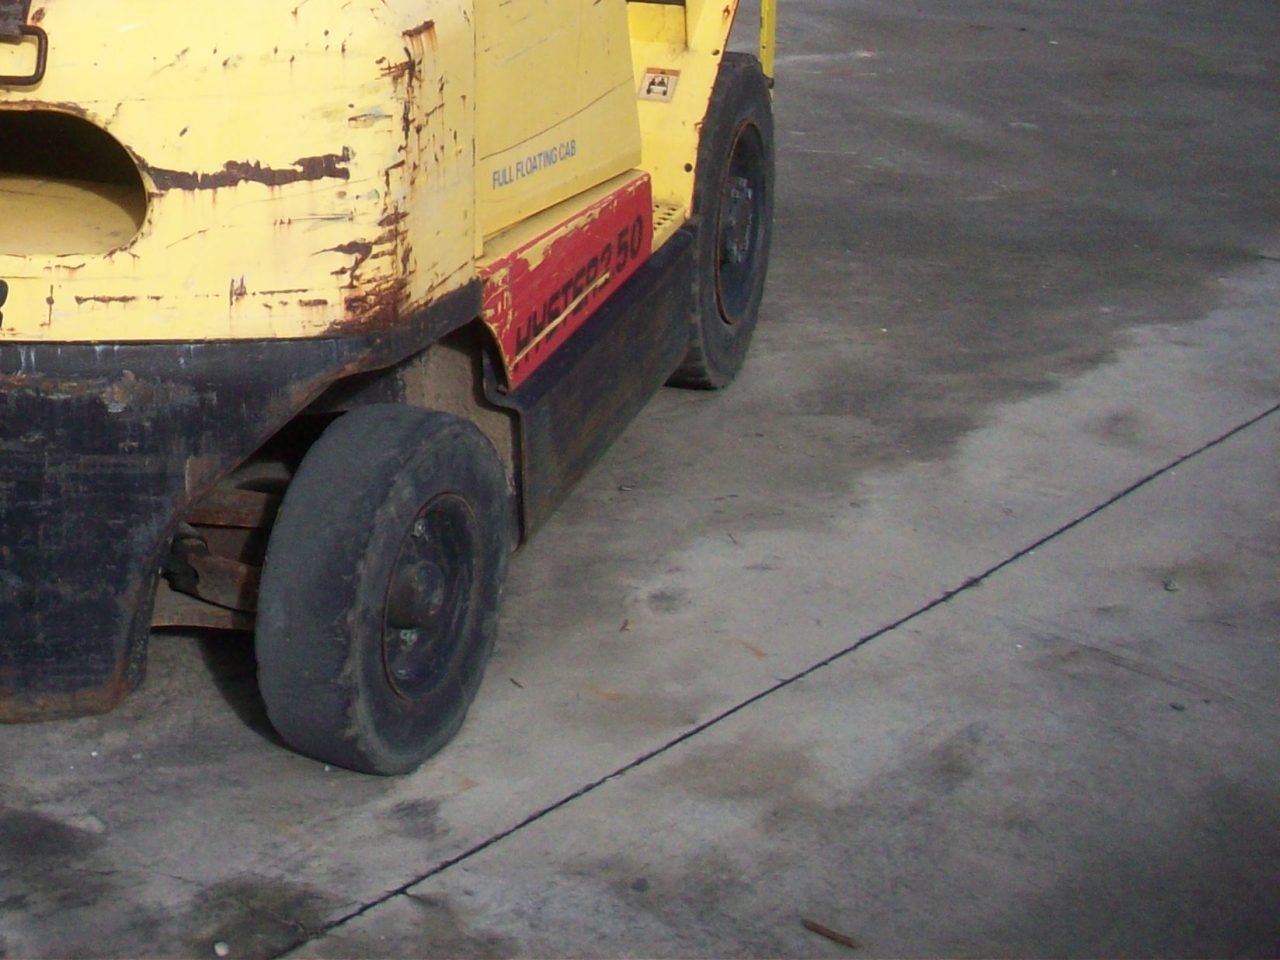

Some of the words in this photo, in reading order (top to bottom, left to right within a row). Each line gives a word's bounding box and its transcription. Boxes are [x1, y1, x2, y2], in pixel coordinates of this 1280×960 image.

[492, 165, 514, 190] FULL
[515, 147, 558, 180] FLOATING
[559, 139, 576, 161] CAB
